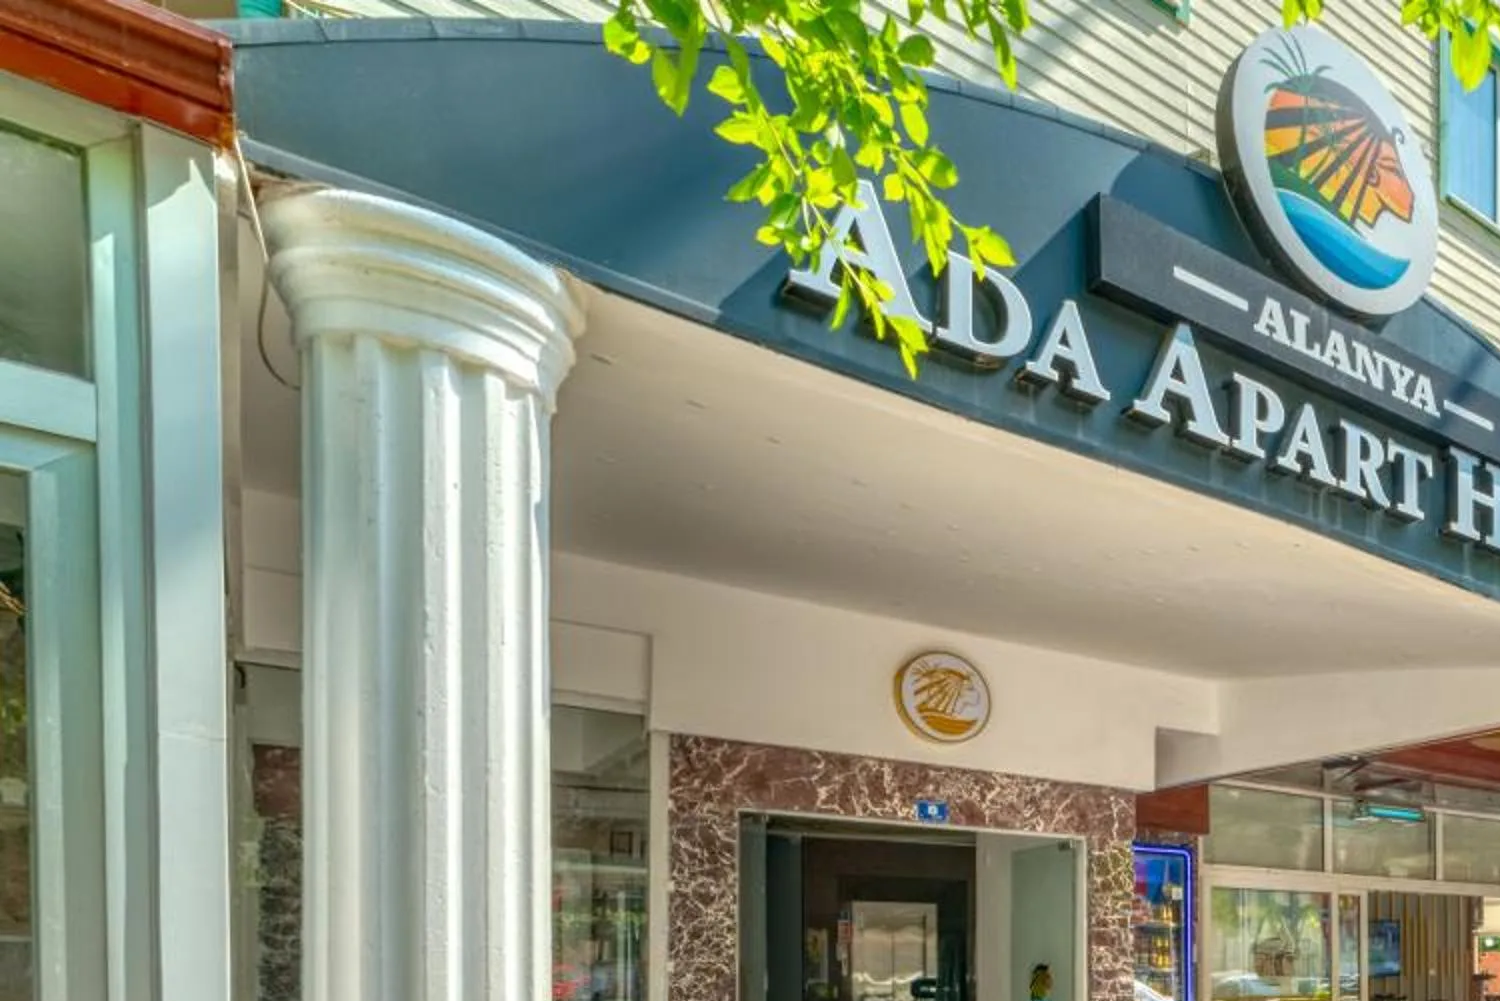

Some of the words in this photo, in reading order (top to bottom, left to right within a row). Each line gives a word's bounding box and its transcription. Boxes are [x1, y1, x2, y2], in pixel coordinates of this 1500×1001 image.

[788, 178, 1111, 401] ADA
[1133, 322, 1434, 521] APART
[1253, 296, 1441, 418] ALANYA
